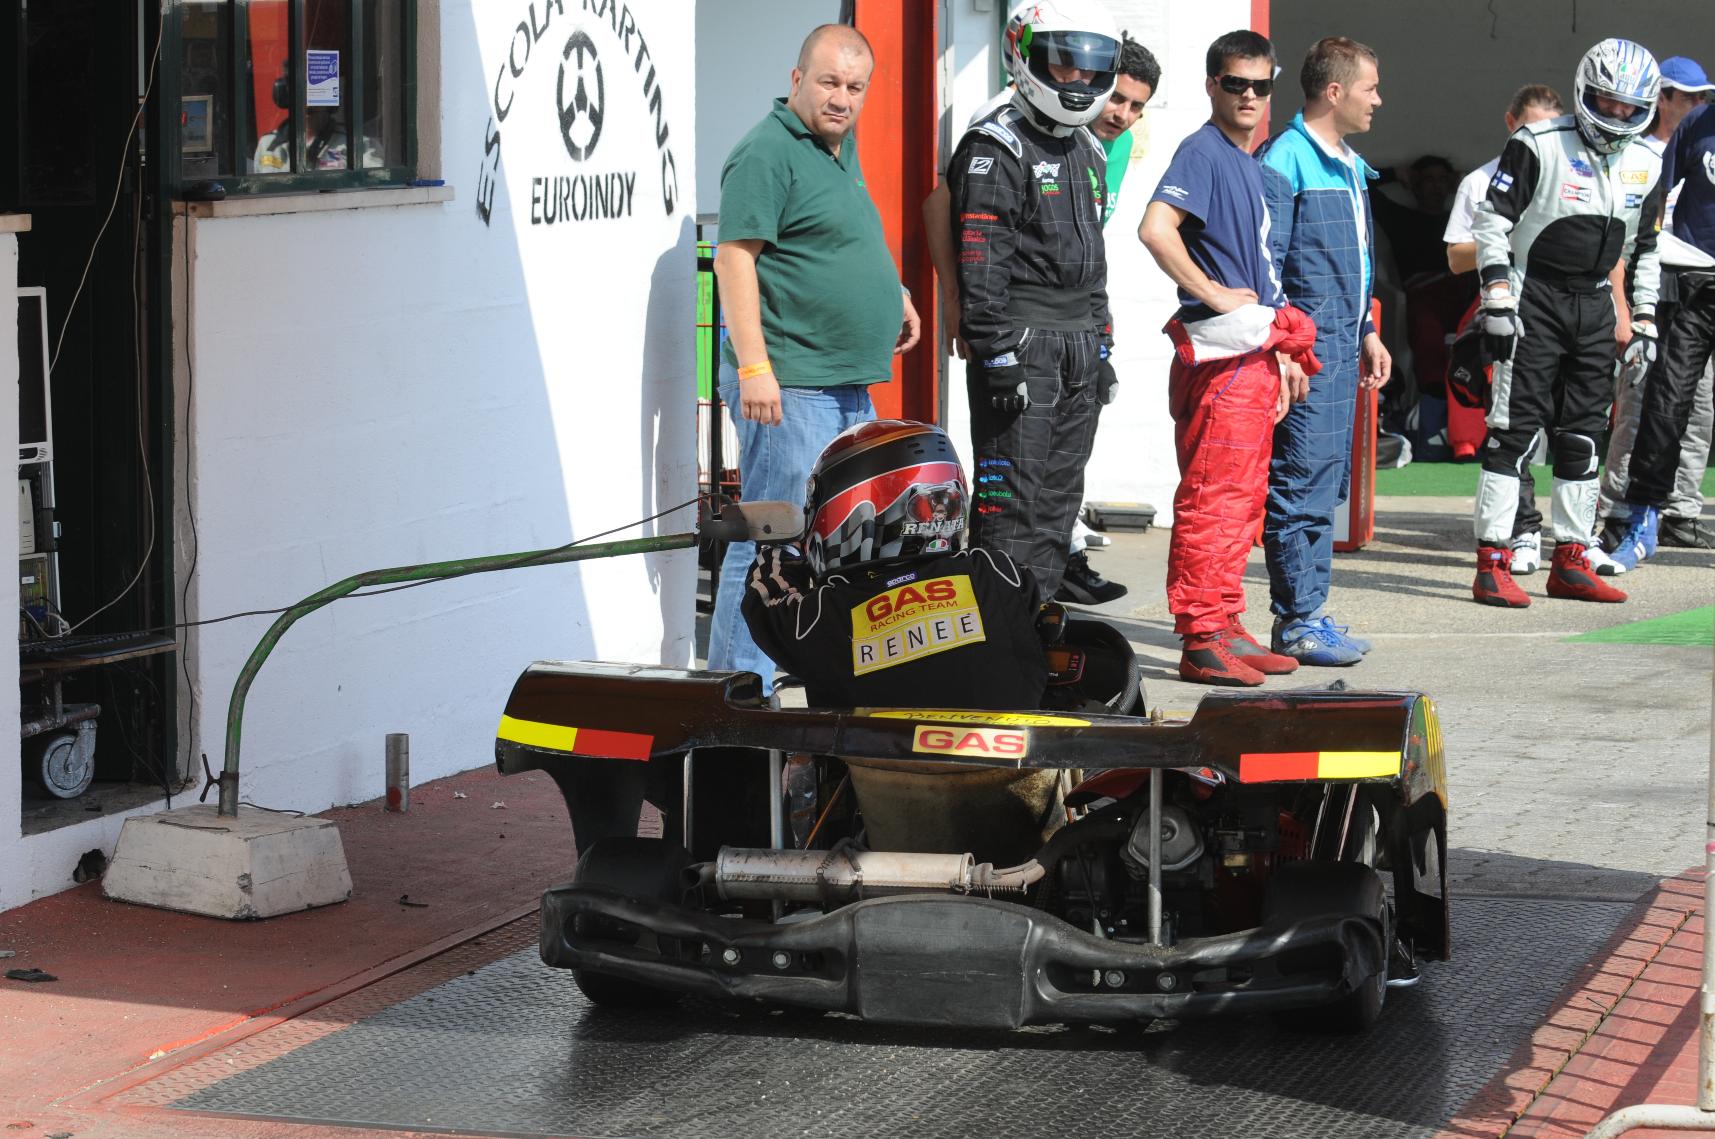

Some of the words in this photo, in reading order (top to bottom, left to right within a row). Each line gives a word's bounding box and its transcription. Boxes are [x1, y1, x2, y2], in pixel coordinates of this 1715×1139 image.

[531, 171, 636, 225] EUROINDY
[865, 579, 957, 623] GAS
[870, 607, 916, 633] RACING
[919, 600, 959, 613] TEAM
[918, 729, 1025, 754] GAS
